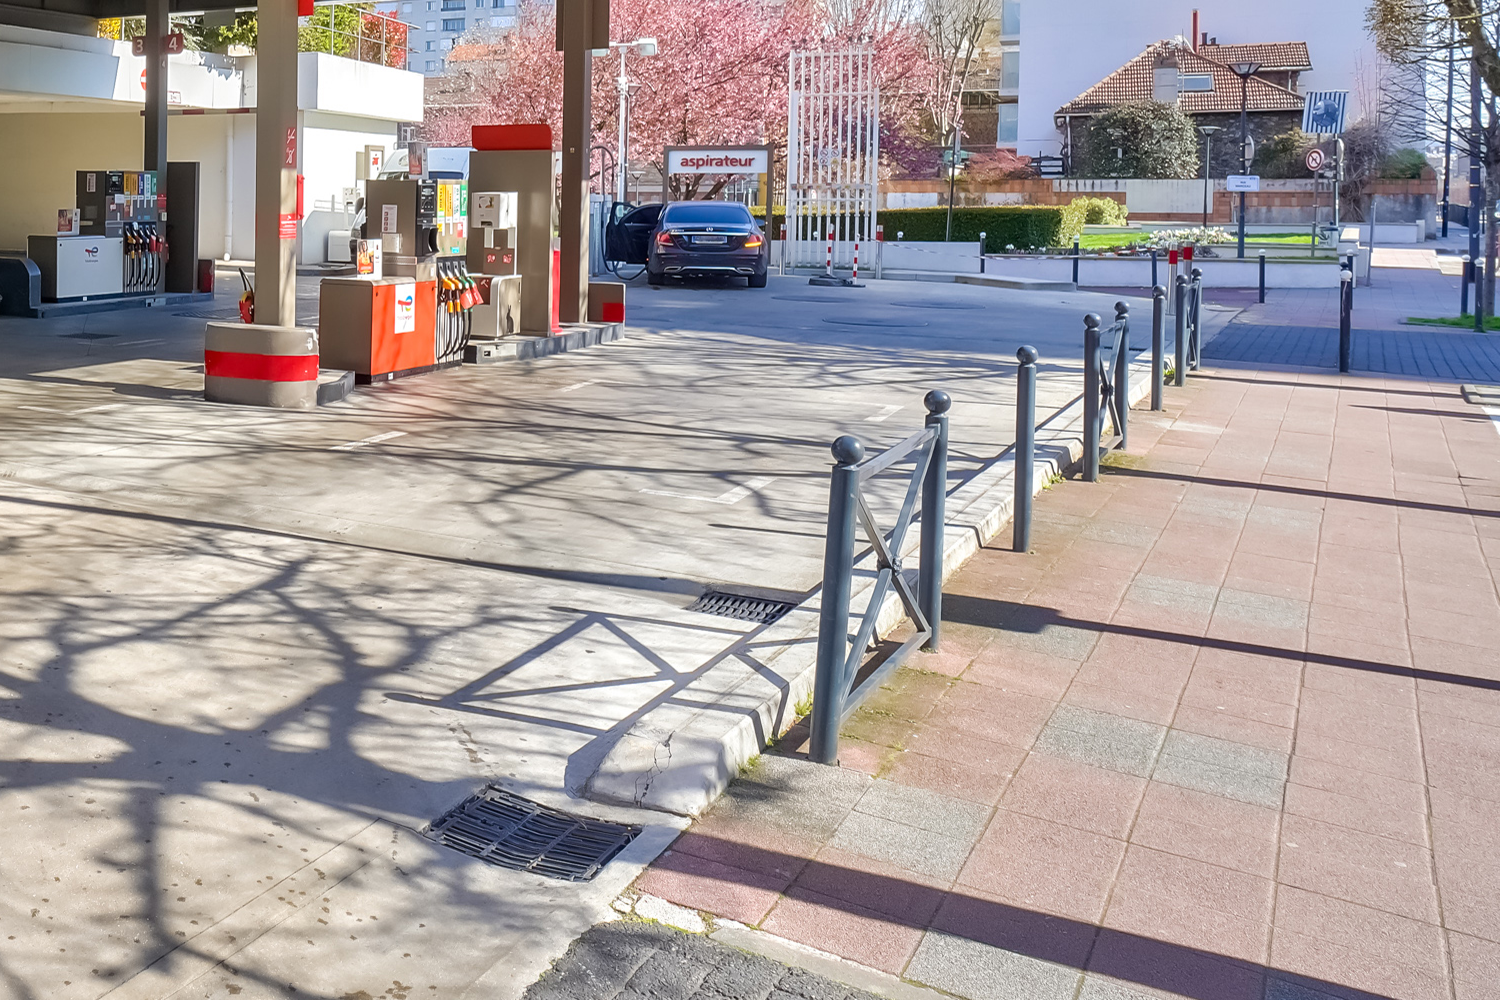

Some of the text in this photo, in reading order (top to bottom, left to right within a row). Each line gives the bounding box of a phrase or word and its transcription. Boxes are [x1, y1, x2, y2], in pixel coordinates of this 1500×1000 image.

[136, 39, 144, 53] 3
[168, 36, 178, 51] 4
[680, 154, 755, 170] aspirateur
